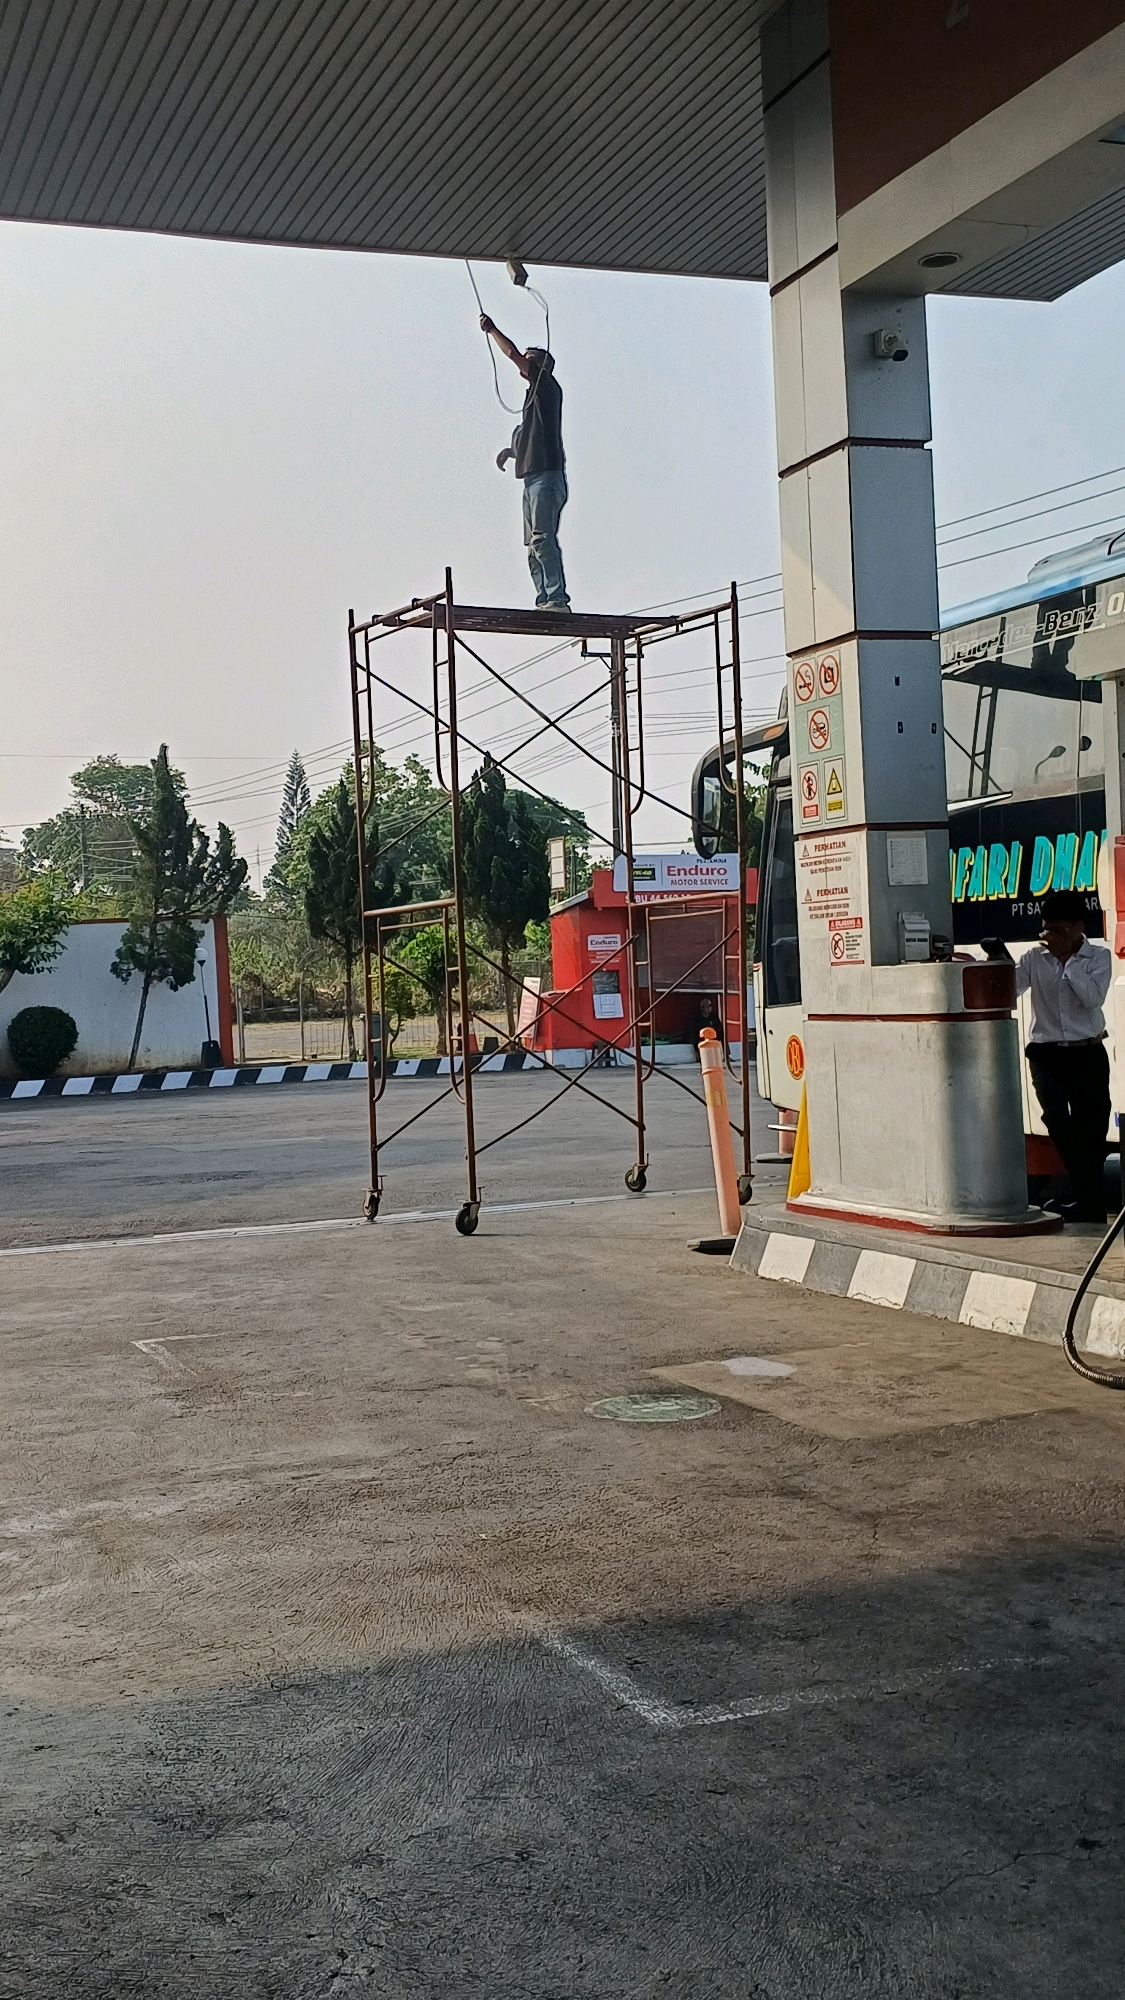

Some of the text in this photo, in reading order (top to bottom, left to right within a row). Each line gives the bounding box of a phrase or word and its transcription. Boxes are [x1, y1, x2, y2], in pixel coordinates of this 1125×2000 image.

[942, 601, 1103, 665] Mercedes-Benz
[814, 841, 846, 852] PERHATIAN
[667, 865, 728, 877] Enduro
[700, 878, 728, 886] SERVICE
[816, 886, 849, 897] PERHATIAN
[625, 894, 648, 904] SBU
[1012, 902, 1024, 917] PT
